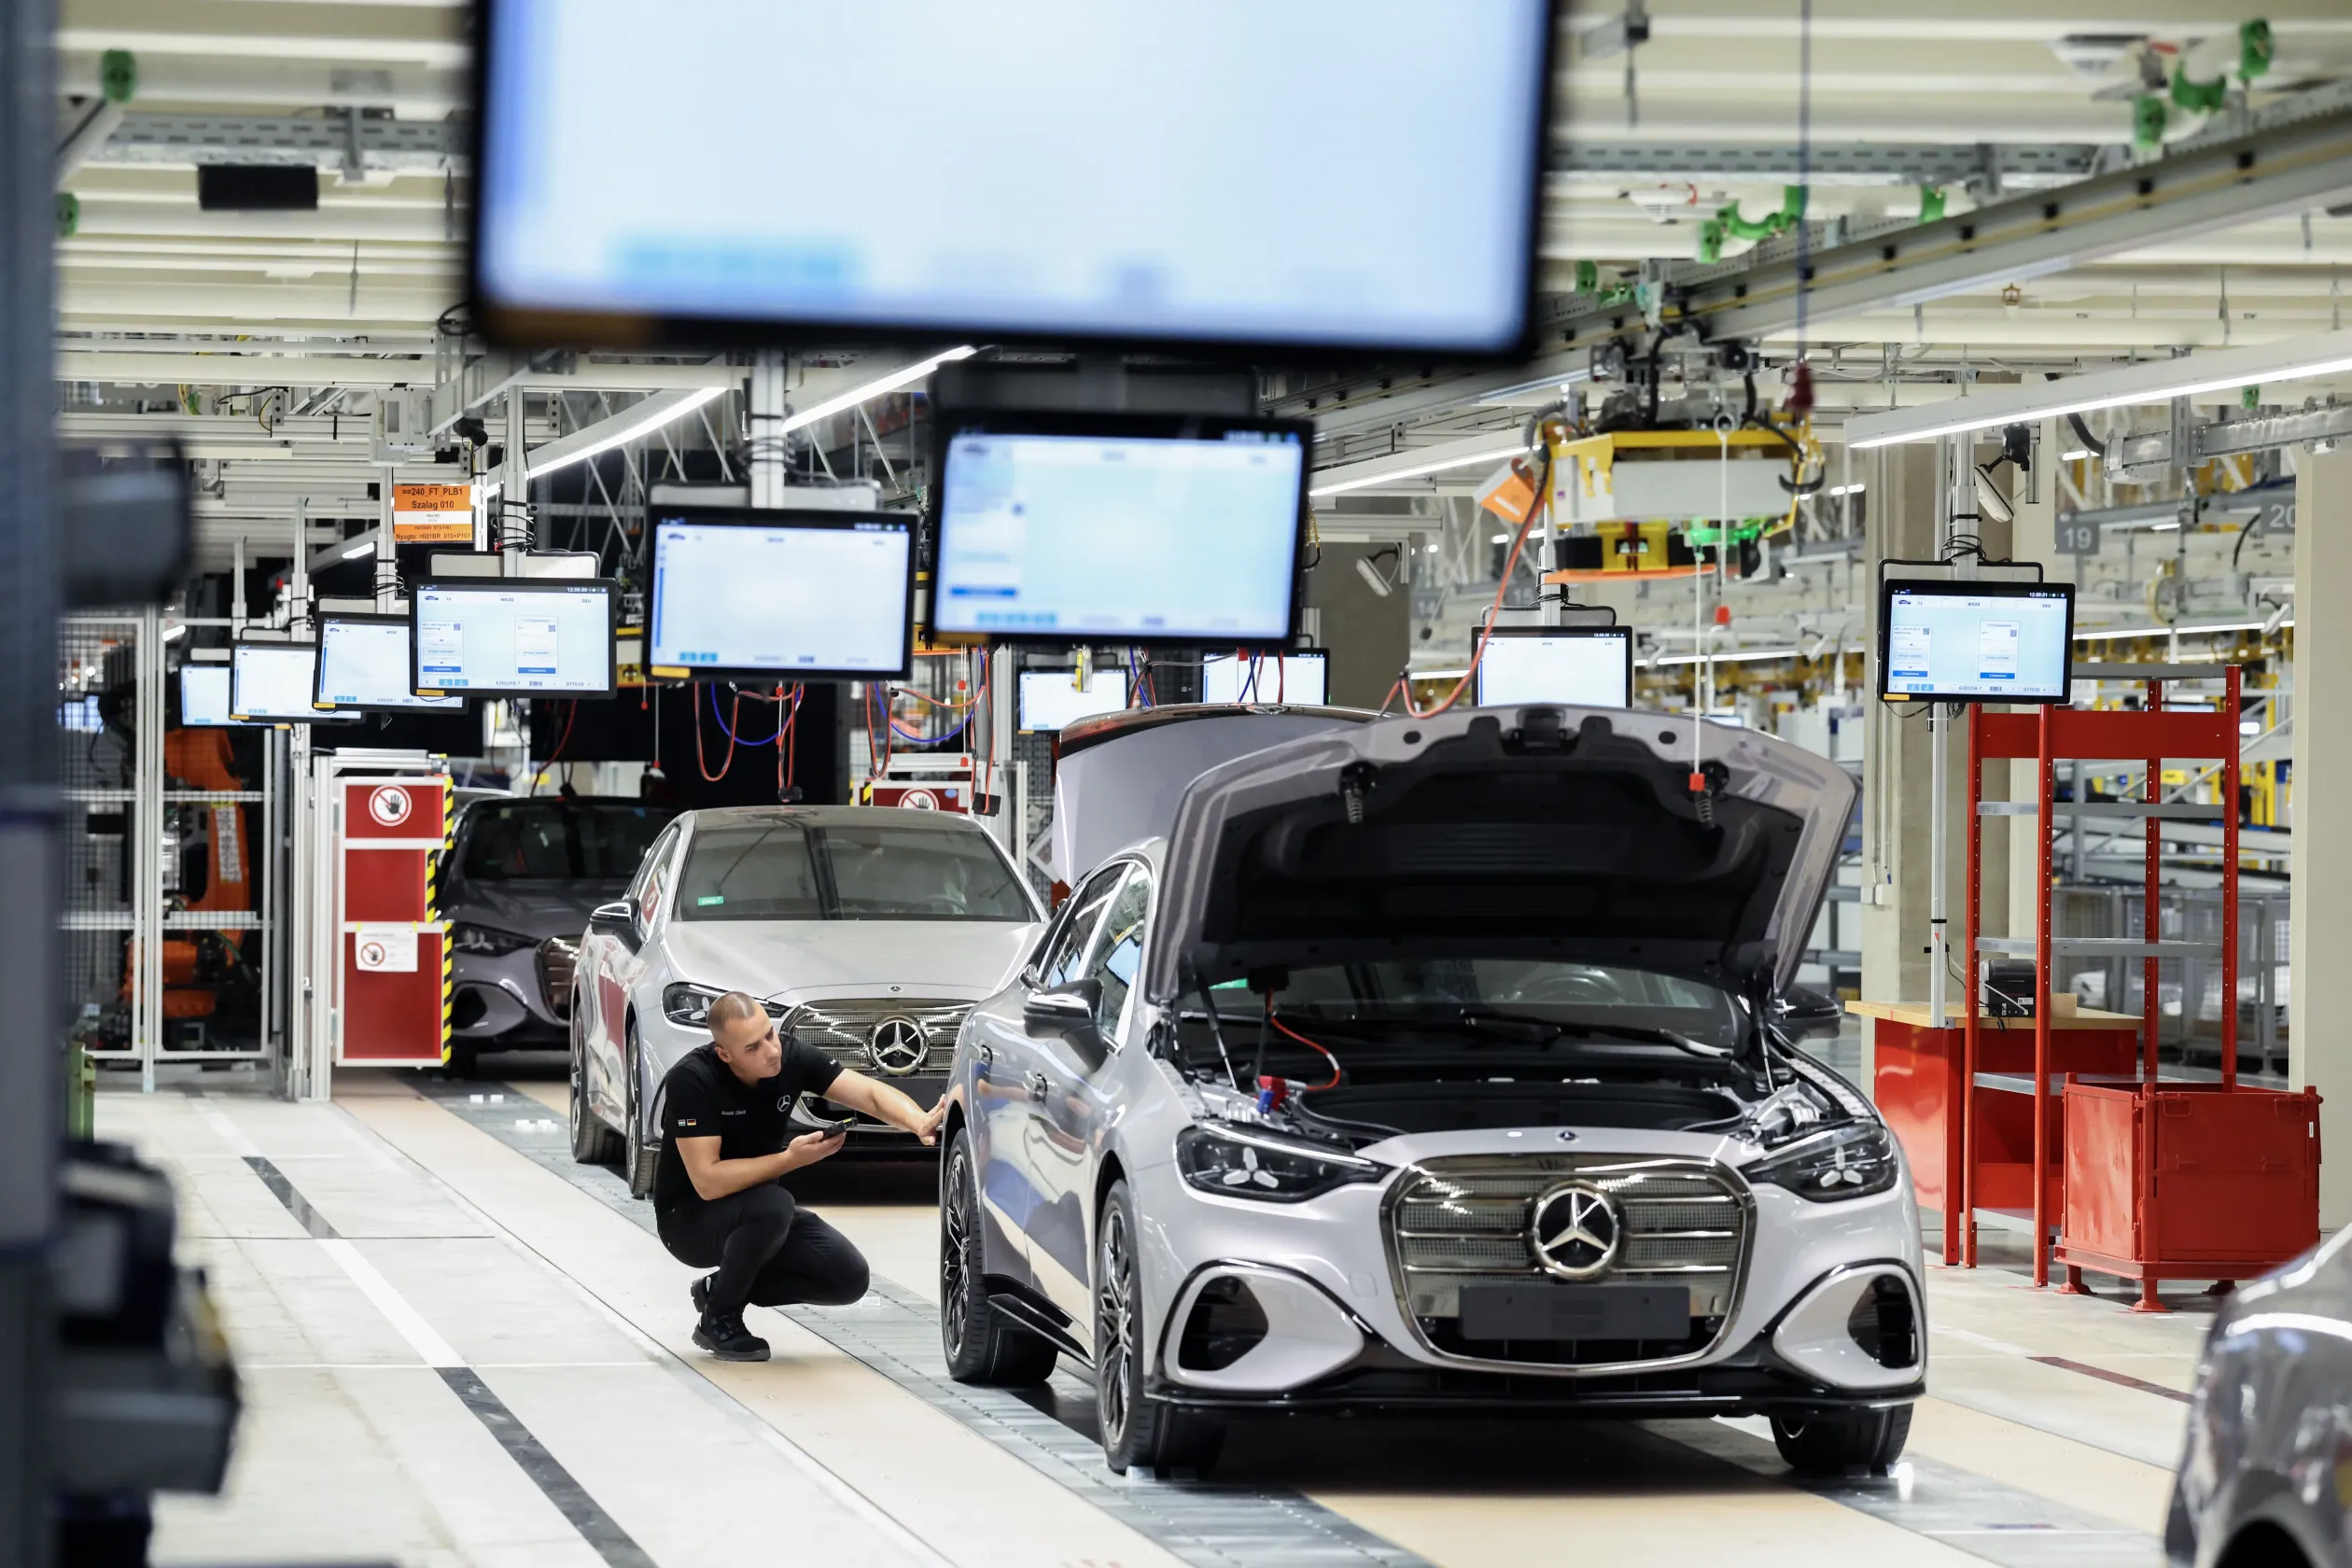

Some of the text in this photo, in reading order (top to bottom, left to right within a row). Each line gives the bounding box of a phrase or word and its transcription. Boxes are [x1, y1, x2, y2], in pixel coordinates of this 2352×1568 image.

[412, 500, 455, 511] Szalag 010
[2064, 527, 2093, 549] 19
